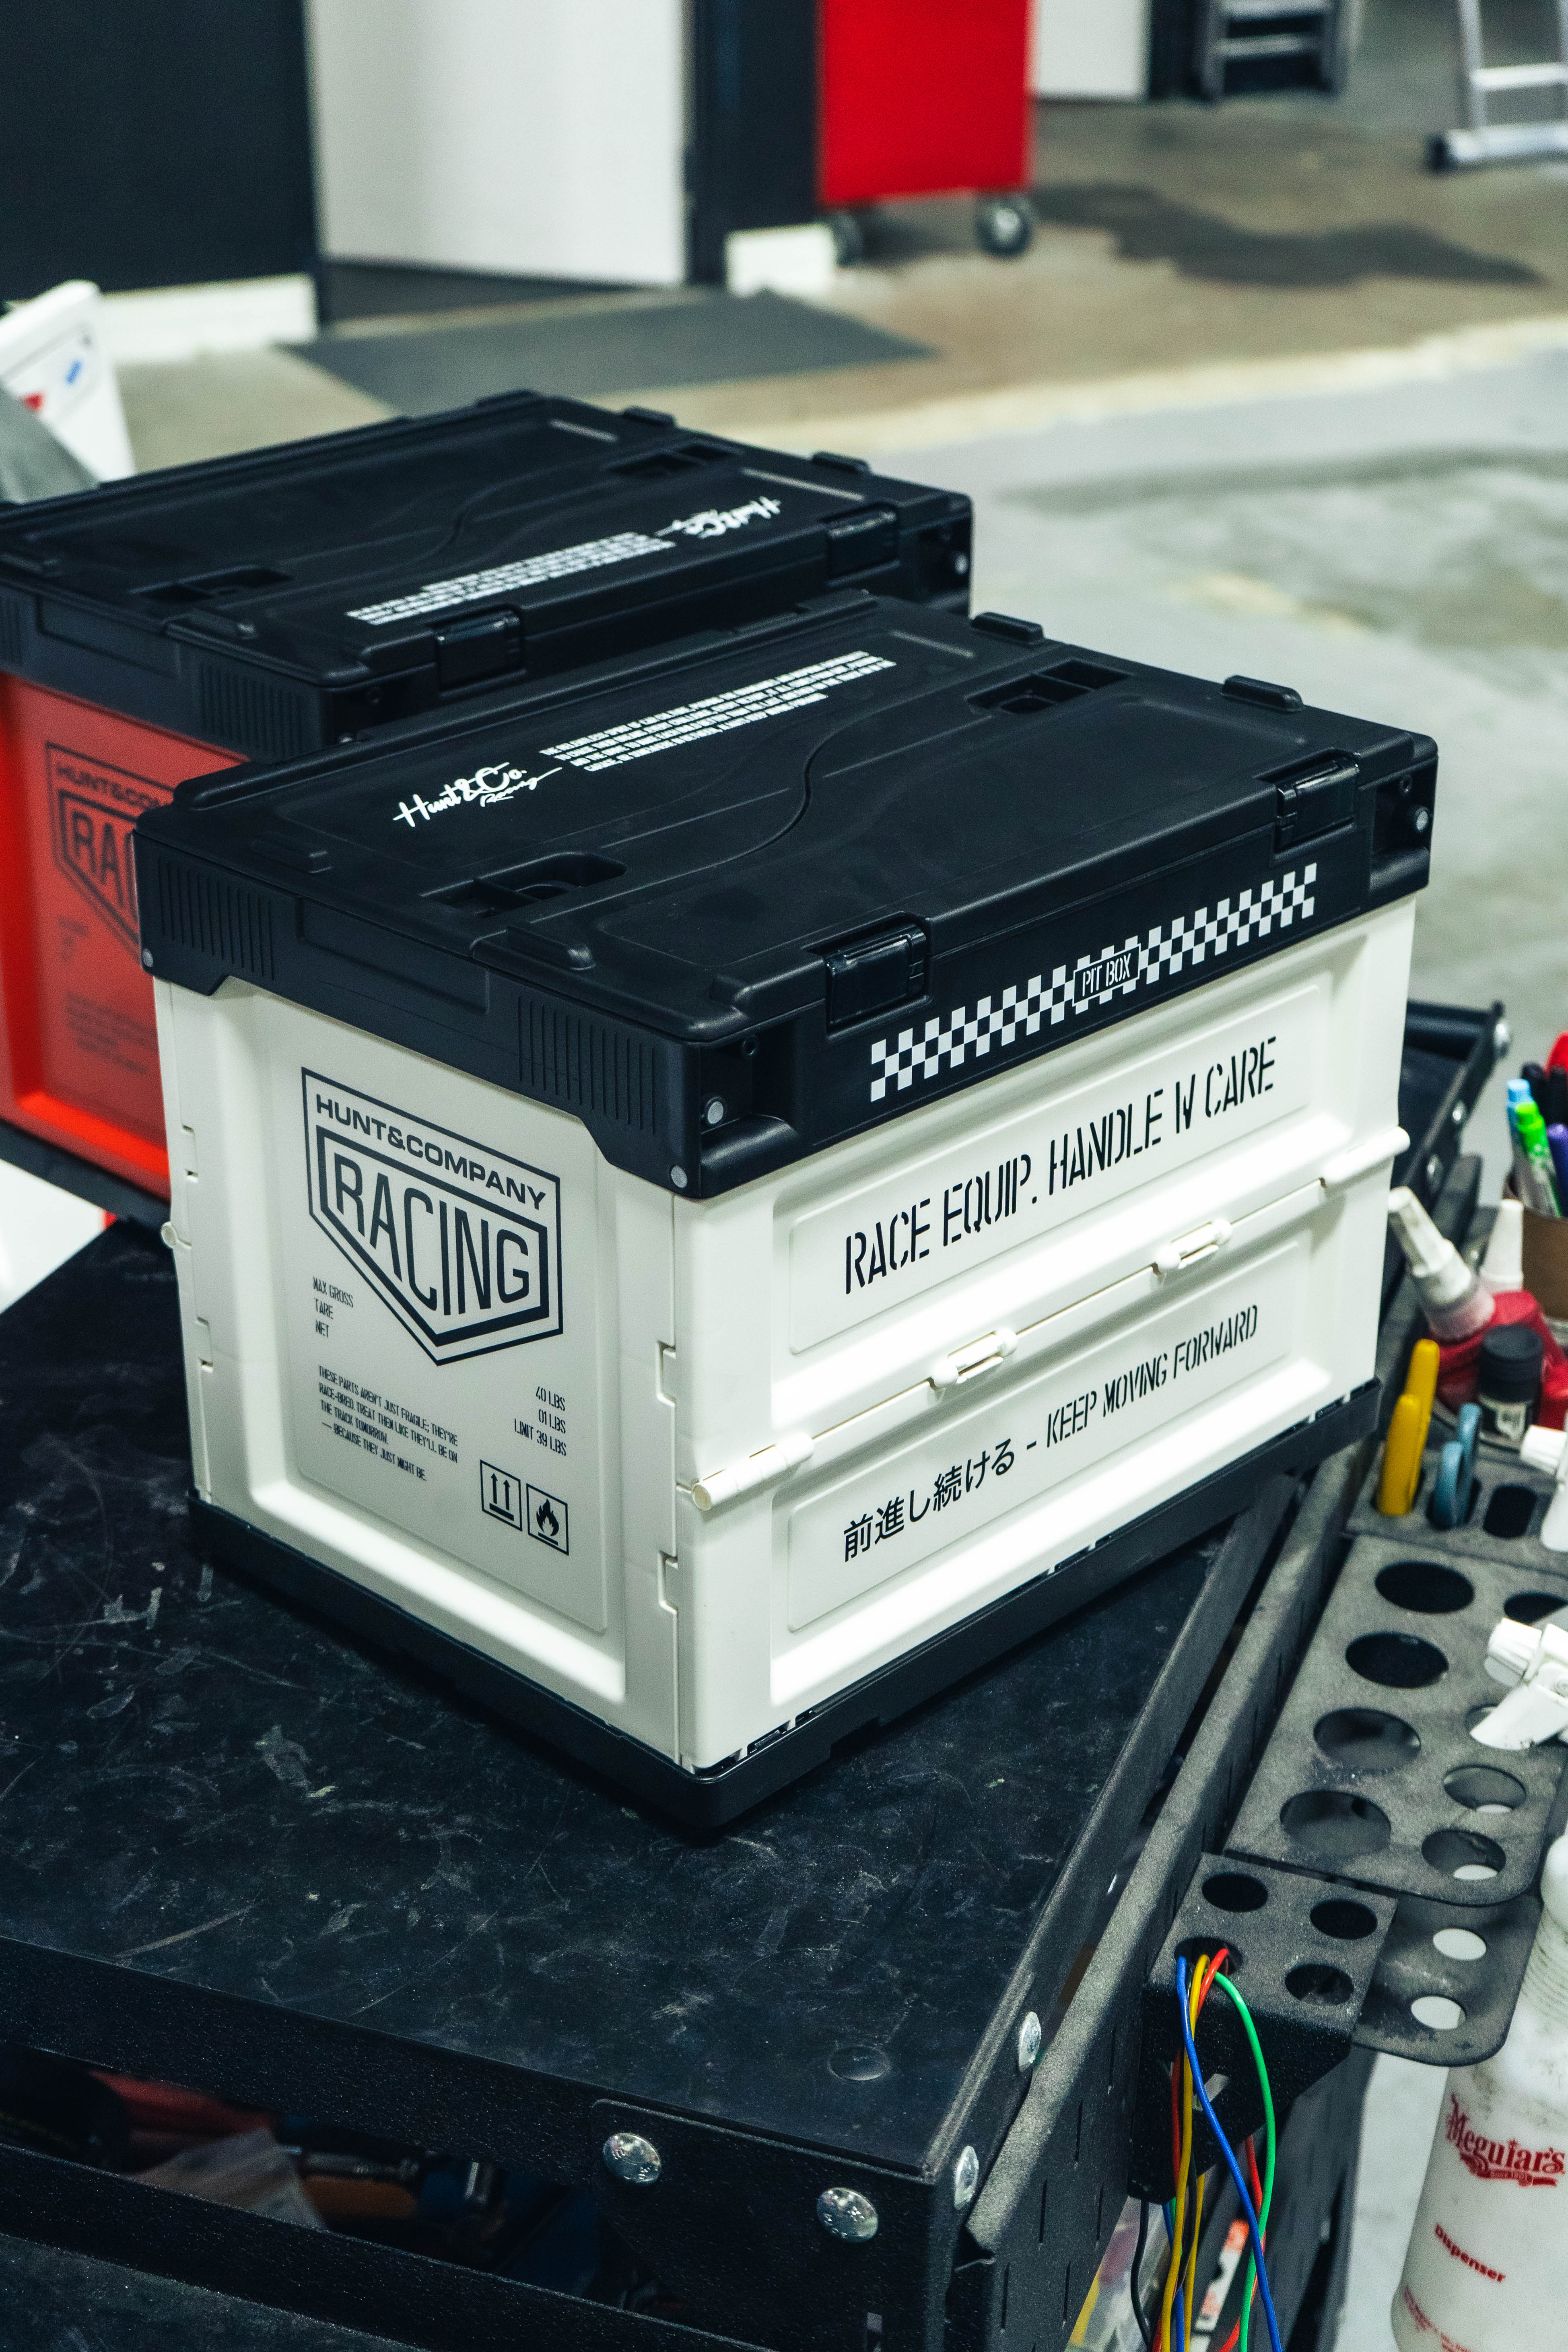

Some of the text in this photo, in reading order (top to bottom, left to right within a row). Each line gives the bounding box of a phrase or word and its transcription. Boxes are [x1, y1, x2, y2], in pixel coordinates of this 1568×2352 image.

[1082, 952, 1131, 997] PIT BOX
[316, 1094, 546, 1211] HUNT&COMPANY
[845, 1198, 930, 1295] RACE
[943, 1154, 1037, 1247] EQUIP.
[1049, 1088, 1164, 1196] HANDLE
[1205, 1036, 1276, 1118] CARE
[334, 1152, 529, 1316] RACING
[313, 1276, 353, 1308] MAX GROSS
[314, 1297, 334, 1319] TARE
[316, 1319, 329, 1338] NET
[319, 1365, 338, 1385] THESE
[339, 1375, 359, 1395] PARTS
[361, 1387, 382, 1407] AREN'T
[384, 1400, 399, 1416] JUST
[431, 1423, 458, 1447] THEY'RE
[321, 1399, 333, 1416] THE
[334, 1406, 353, 1426] TRACK
[536, 1386, 565, 1411] 40 LBS
[538, 1409, 566, 1434] 01 LBS
[334, 1422, 361, 1447] BECAUSE
[363, 1437, 378, 1455] THEY
[381, 1448, 395, 1464] JUST
[397, 1455, 415, 1474] MIGHT
[416, 1466, 427, 1482] BE.
[356, 1401, 375, 1420] TREAT
[377, 1412, 394, 1430] THEM
[395, 1421, 408, 1439] LIKE
[410, 1429, 437, 1453] THEY'LL
[439, 1443, 447, 1458] BE
[449, 1449, 457, 1464] ON
[515, 1418, 567, 1456] LIMIT 39 LBS
[844, 1438, 1015, 1563] 前進し続ける
[1047, 1391, 1096, 1448] KEEP
[1103, 1353, 1167, 1417] MOVING
[1173, 1305, 1257, 1379] FORWARD
[1446, 2093, 1566, 2176] Meguiar's
[1435, 2222, 1506, 2283] Dispenser
